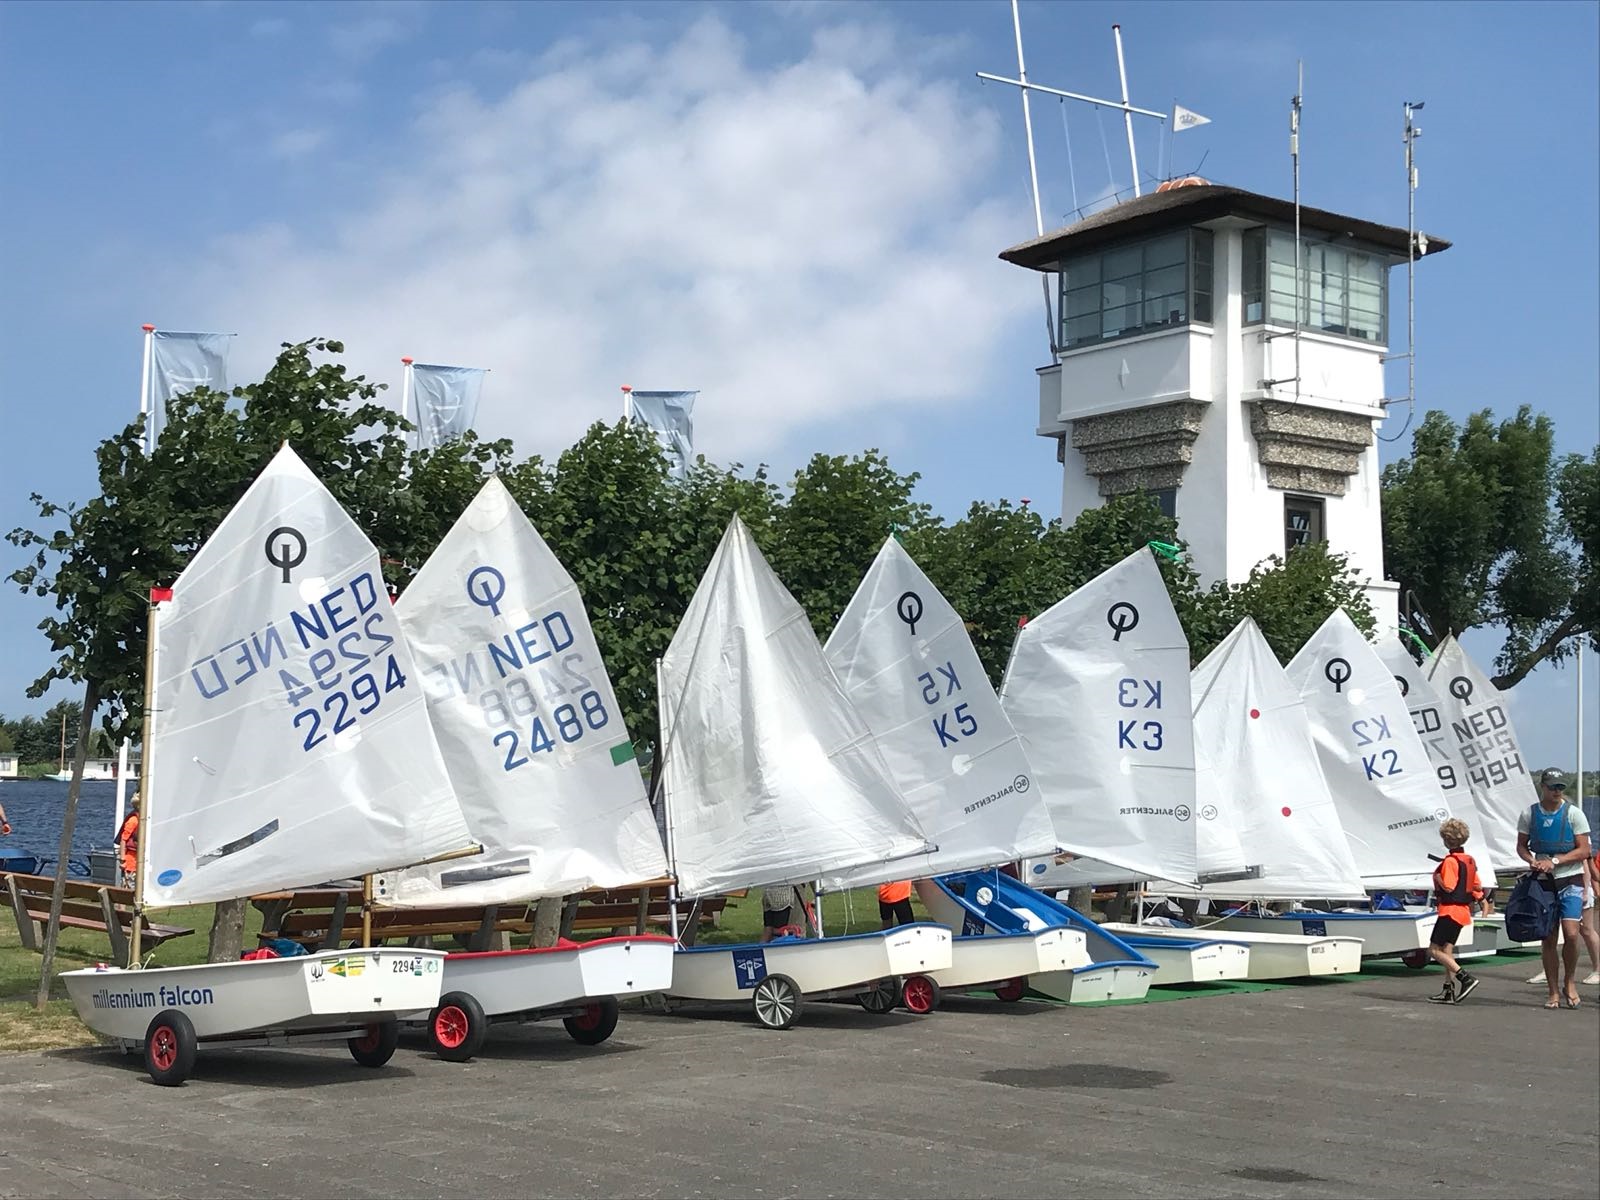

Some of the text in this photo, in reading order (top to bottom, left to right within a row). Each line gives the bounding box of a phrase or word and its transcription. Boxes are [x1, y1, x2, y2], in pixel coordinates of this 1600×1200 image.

[289, 572, 378, 650] NED
[488, 611, 574, 679] NED
[293, 653, 407, 752] 2294
[1409, 707, 1442, 735] ED
[493, 691, 609, 772] 2488
[933, 702, 978, 748] K5
[1118, 720, 1163, 751] K3
[1451, 705, 1508, 743] NED
[1362, 749, 1403, 781] K2
[1466, 753, 1525, 793] 494
[392, 960, 414, 973] 2294
[92, 985, 214, 1009] millennium falcon
